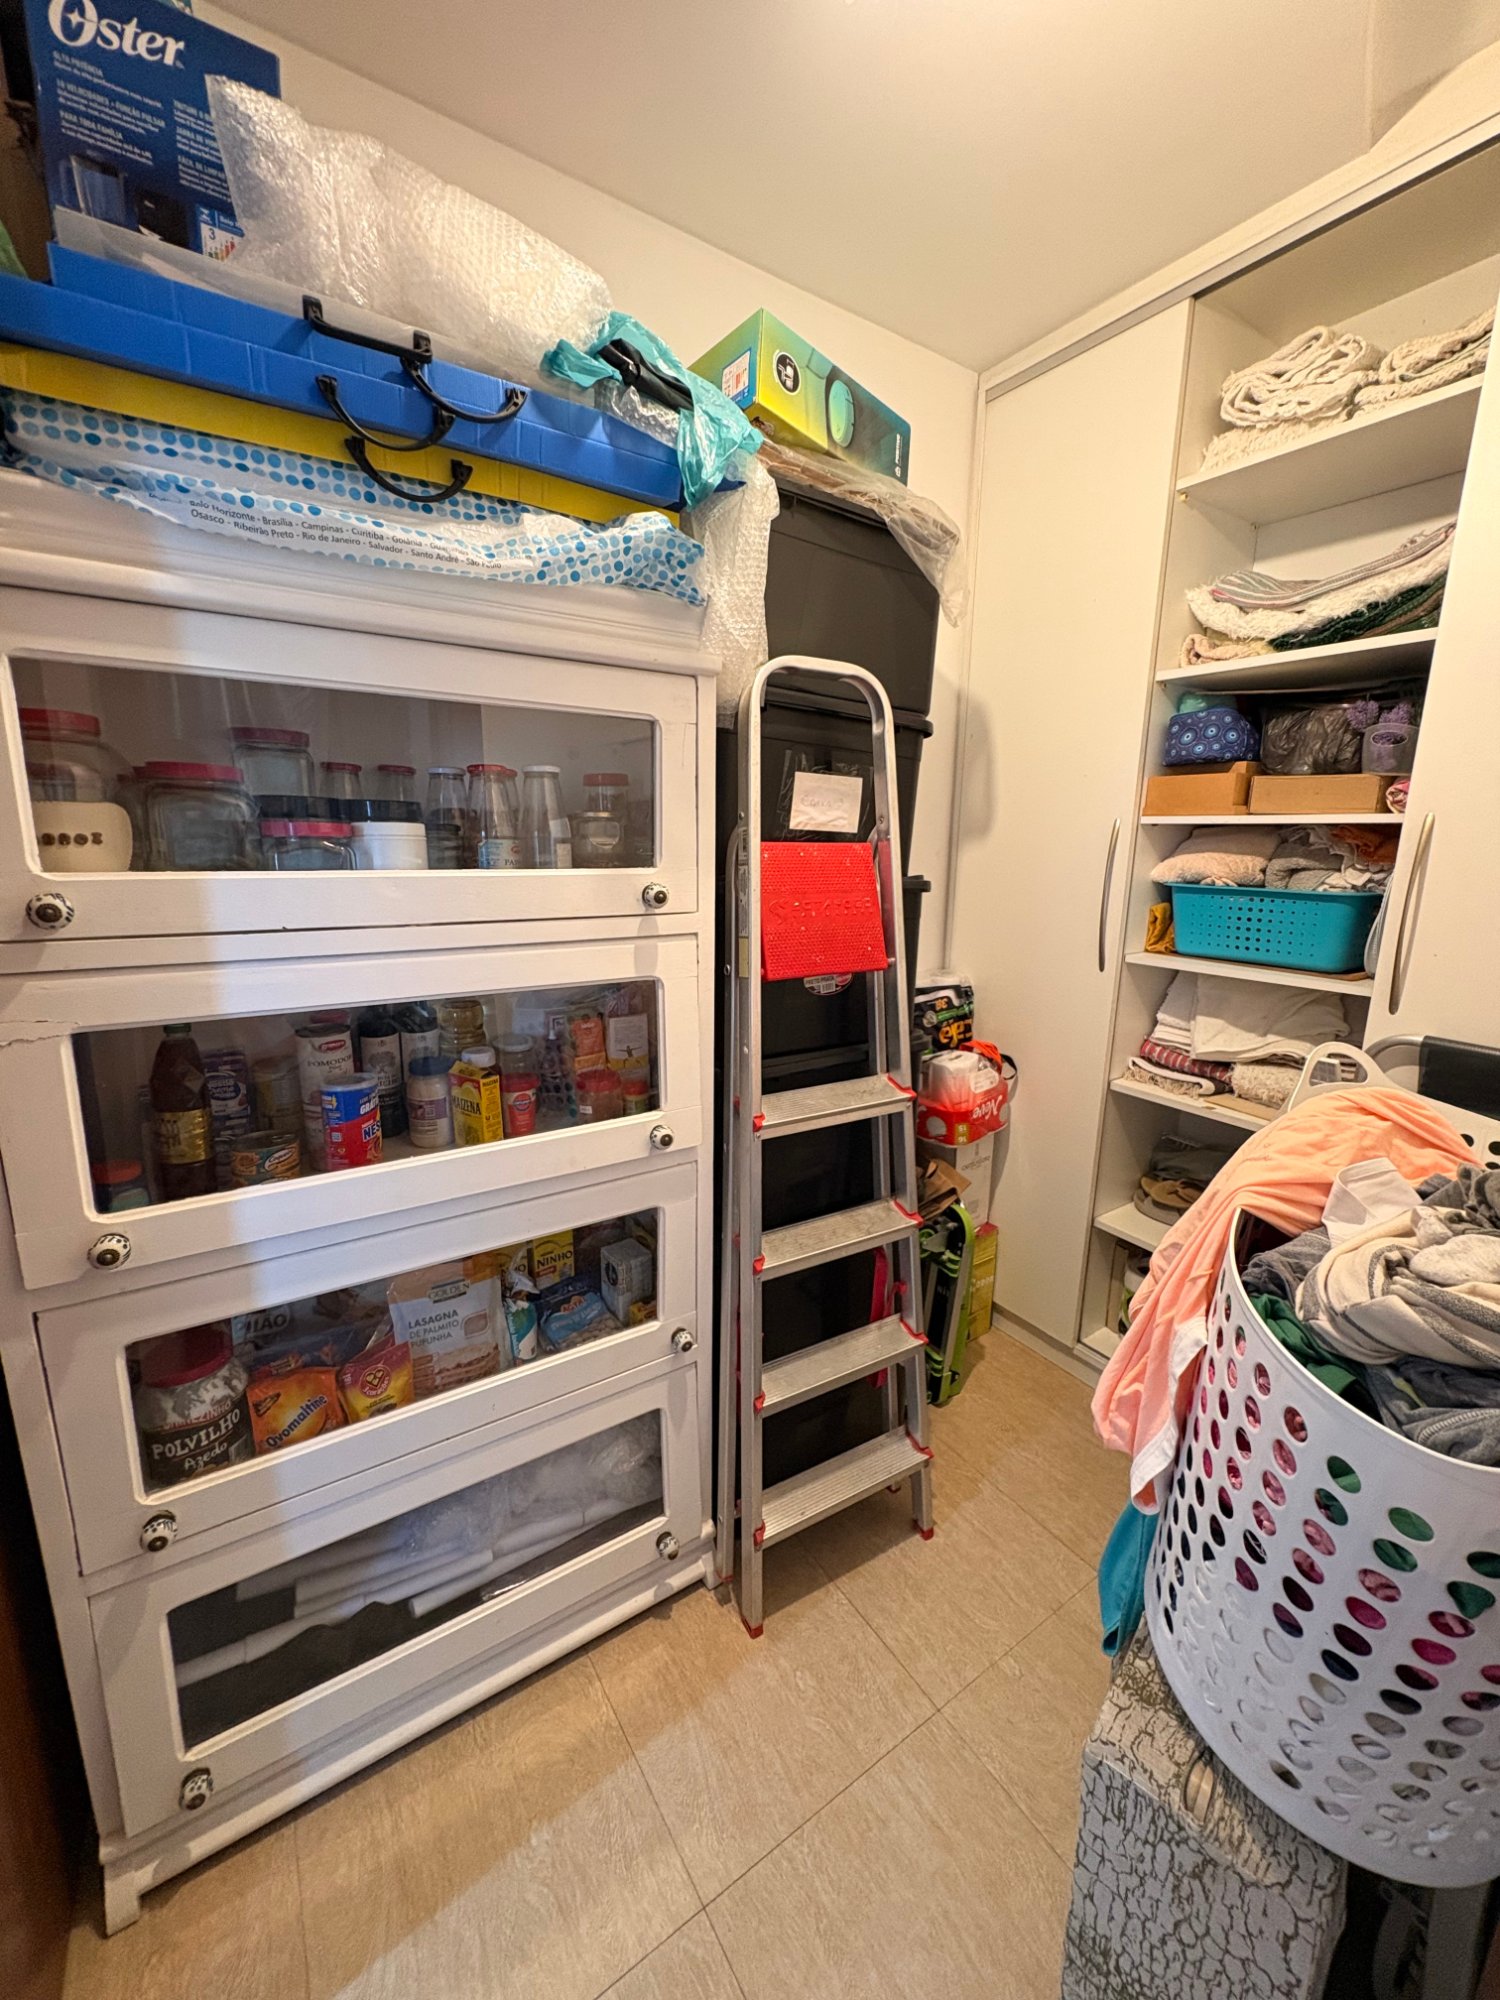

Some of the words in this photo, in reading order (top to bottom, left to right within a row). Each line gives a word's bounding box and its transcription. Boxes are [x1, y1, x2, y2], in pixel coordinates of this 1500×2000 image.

[48, 0, 184, 67] Oster
[191, 509, 224, 524] Osasco
[234, 521, 269, 536] Ribeirão
[271, 529, 294, 539] Preto
[302, 532, 315, 541] Rio
[318, 533, 329, 541] de
[331, 535, 360, 546] Janeiro
[369, 541, 403, 554] Salvador
[411, 549, 433, 560] Santo
[435, 553, 459, 564] André
[466, 557, 480, 567] São
[262, 516, 293, 528] Brasília
[301, 521, 344, 534] Campinas
[352, 528, 384, 541] Curitiba
[392, 535, 423, 547] Goiânia
[972, 1095, 1003, 1120] Neve
[537, 1250, 573, 1268] NINHO
[408, 1309, 459, 1329] LASAGNA
[409, 1330, 421, 1339] DE
[423, 1320, 459, 1336] PALMITO
[152, 1408, 240, 1460] POLVILHO
[265, 1394, 328, 1448] Ovomaltine
[184, 1440, 227, 1472] Azedo
